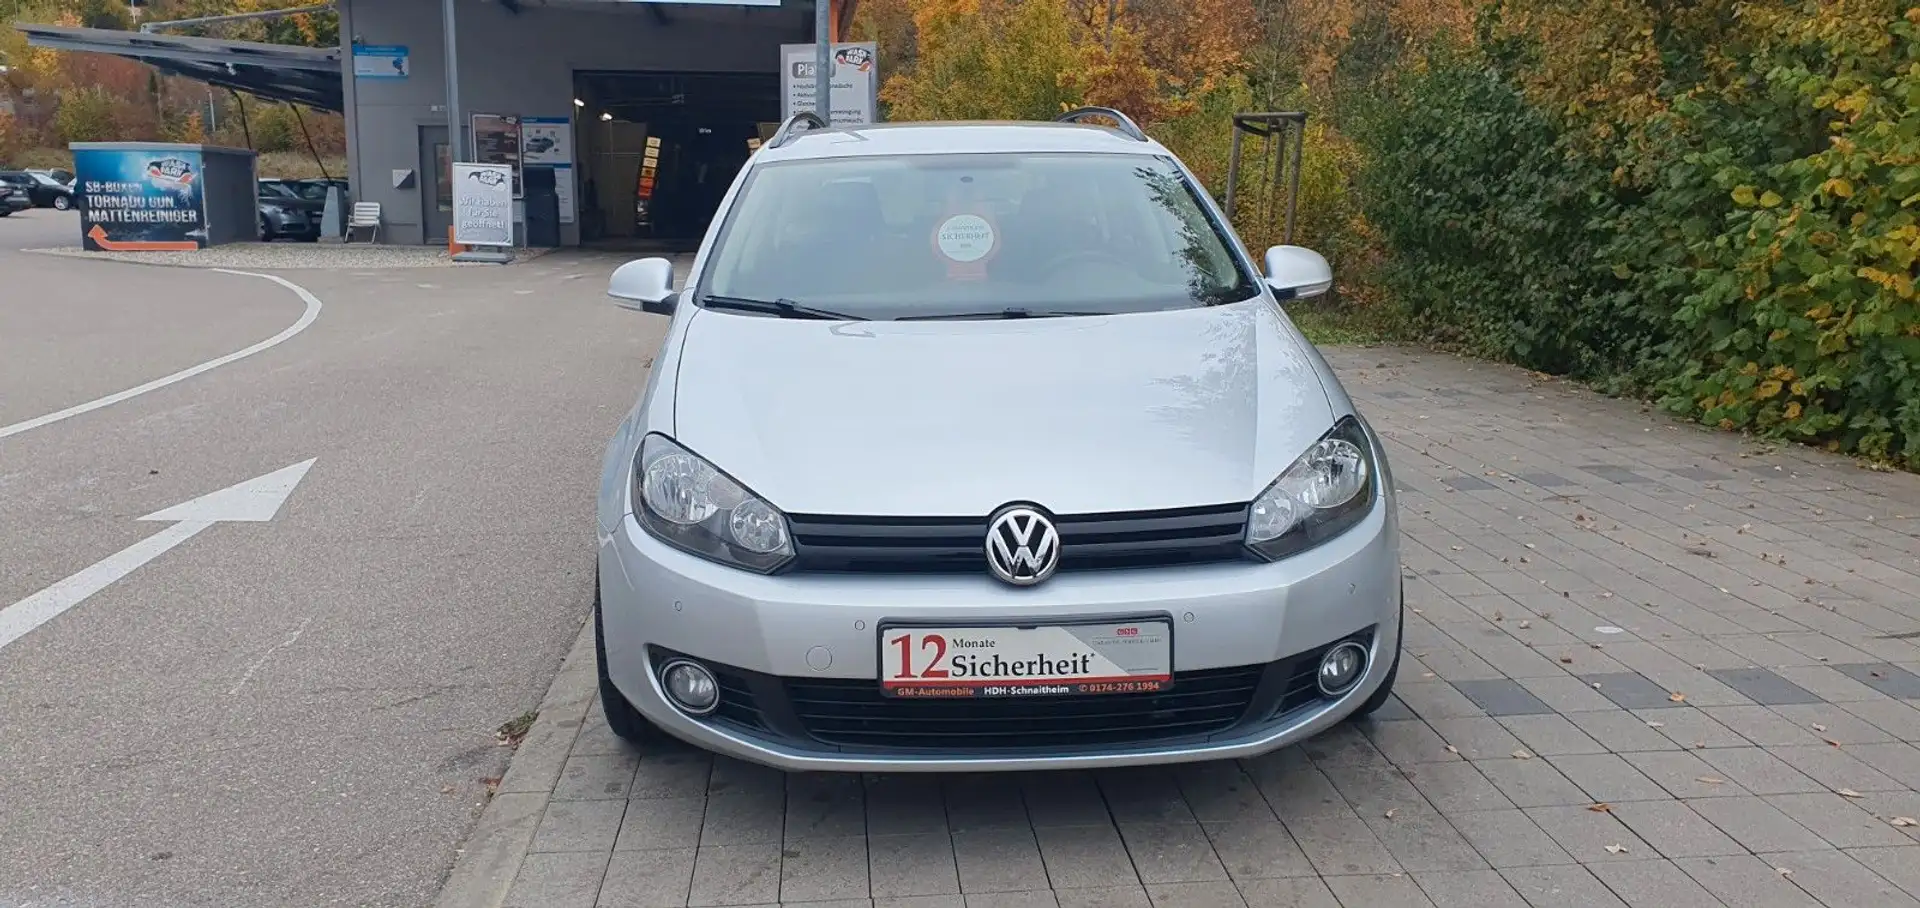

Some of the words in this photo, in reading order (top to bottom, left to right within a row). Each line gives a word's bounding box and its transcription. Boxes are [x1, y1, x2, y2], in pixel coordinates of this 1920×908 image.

[85, 181, 143, 193] SB-BOXEN
[87, 194, 146, 209] TORNADO
[88, 209, 197, 223] MATTENREINIGER
[952, 638, 996, 649] Monate
[891, 633, 949, 679] 12
[897, 686, 975, 697] GM-Automobile
[984, 684, 1070, 696] HDH-Schnaitheim
[1136, 681, 1160, 692] 1994
